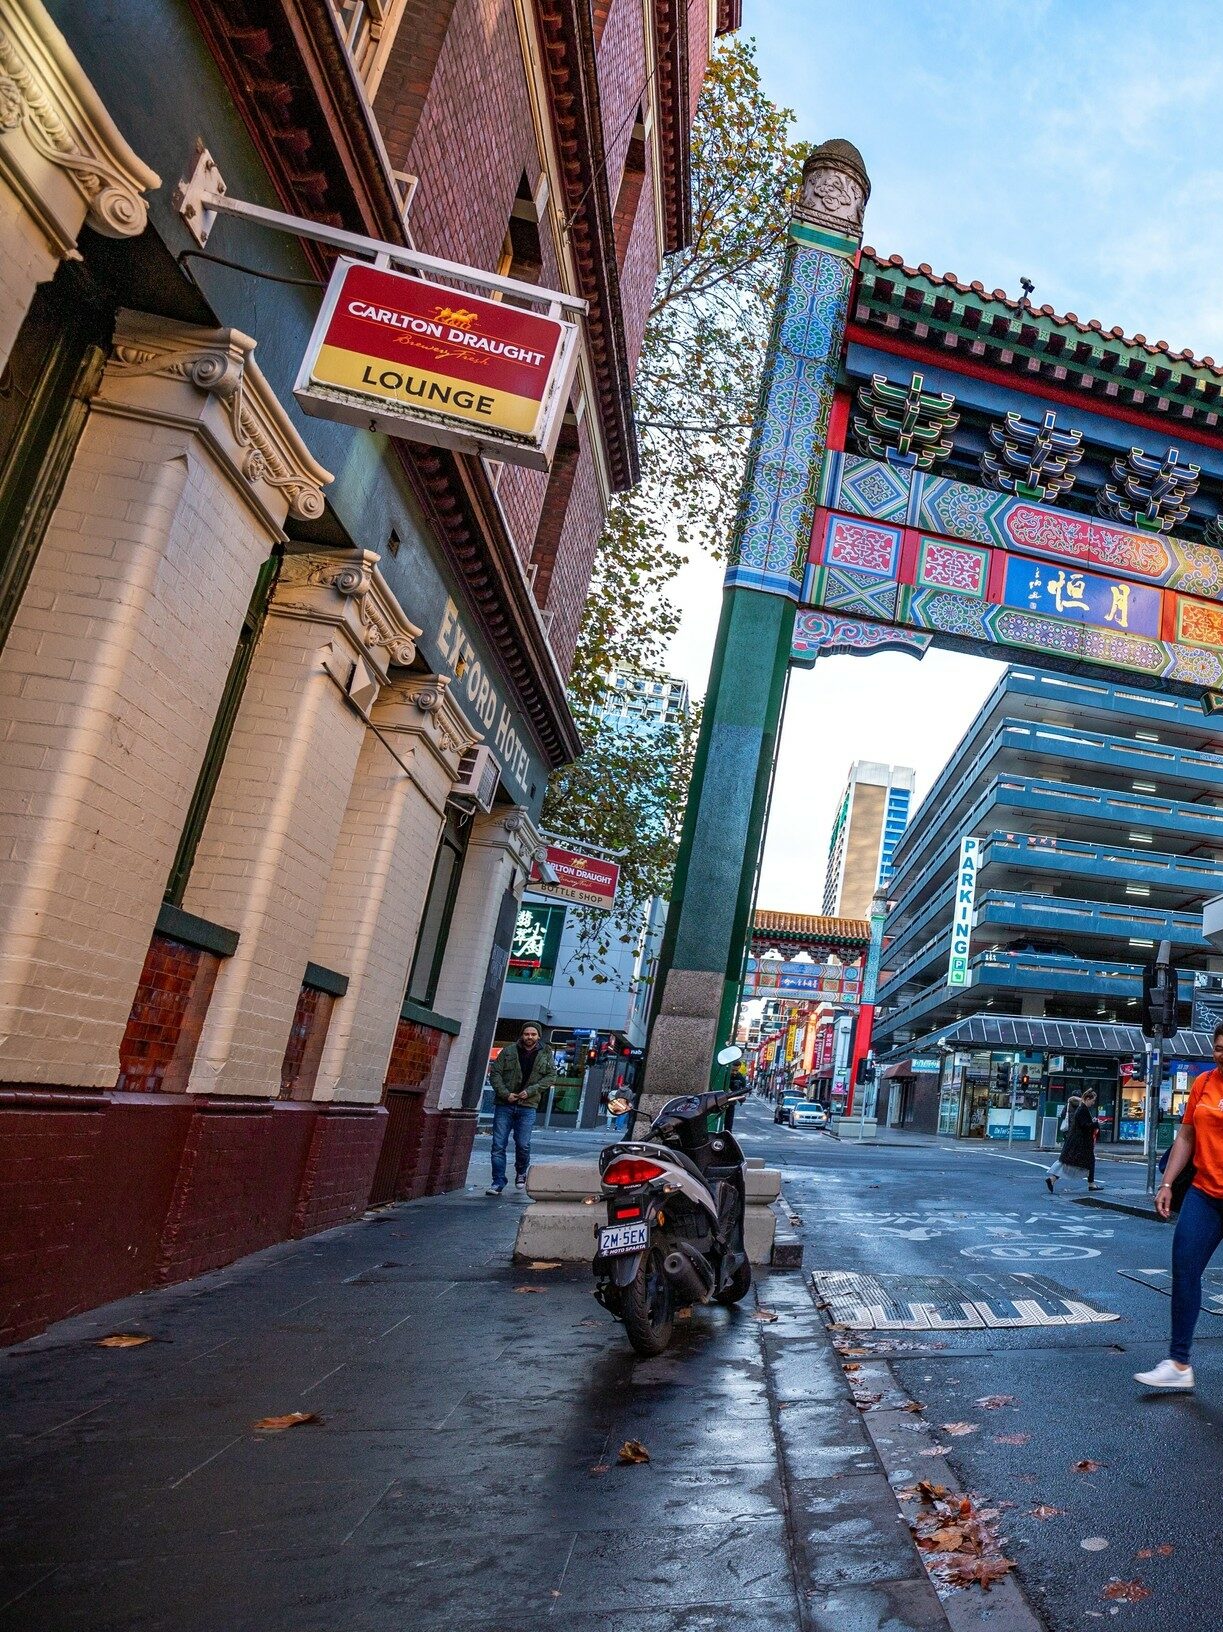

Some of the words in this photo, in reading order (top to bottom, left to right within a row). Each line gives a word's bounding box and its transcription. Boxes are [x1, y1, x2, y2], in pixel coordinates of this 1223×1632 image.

[348, 301, 442, 338] CARLTON
[447, 328, 545, 367] DRAUGHT
[393, 334, 452, 360] Brewery
[450, 349, 490, 366] Fresh
[361, 365, 495, 415] LOUNGE
[436, 594, 497, 730] EXFORD
[494, 703, 530, 793] HOTEL
[541, 882, 576, 898] BOTTLE
[579, 891, 603, 904] SHOP
[576, 869, 613, 885] DRAUGHT
[954, 840, 976, 954] PARKING
[955, 960, 963, 970] P
[609, 1246, 625, 1255] MOTO
[625, 1244, 646, 1252] SPARTA
